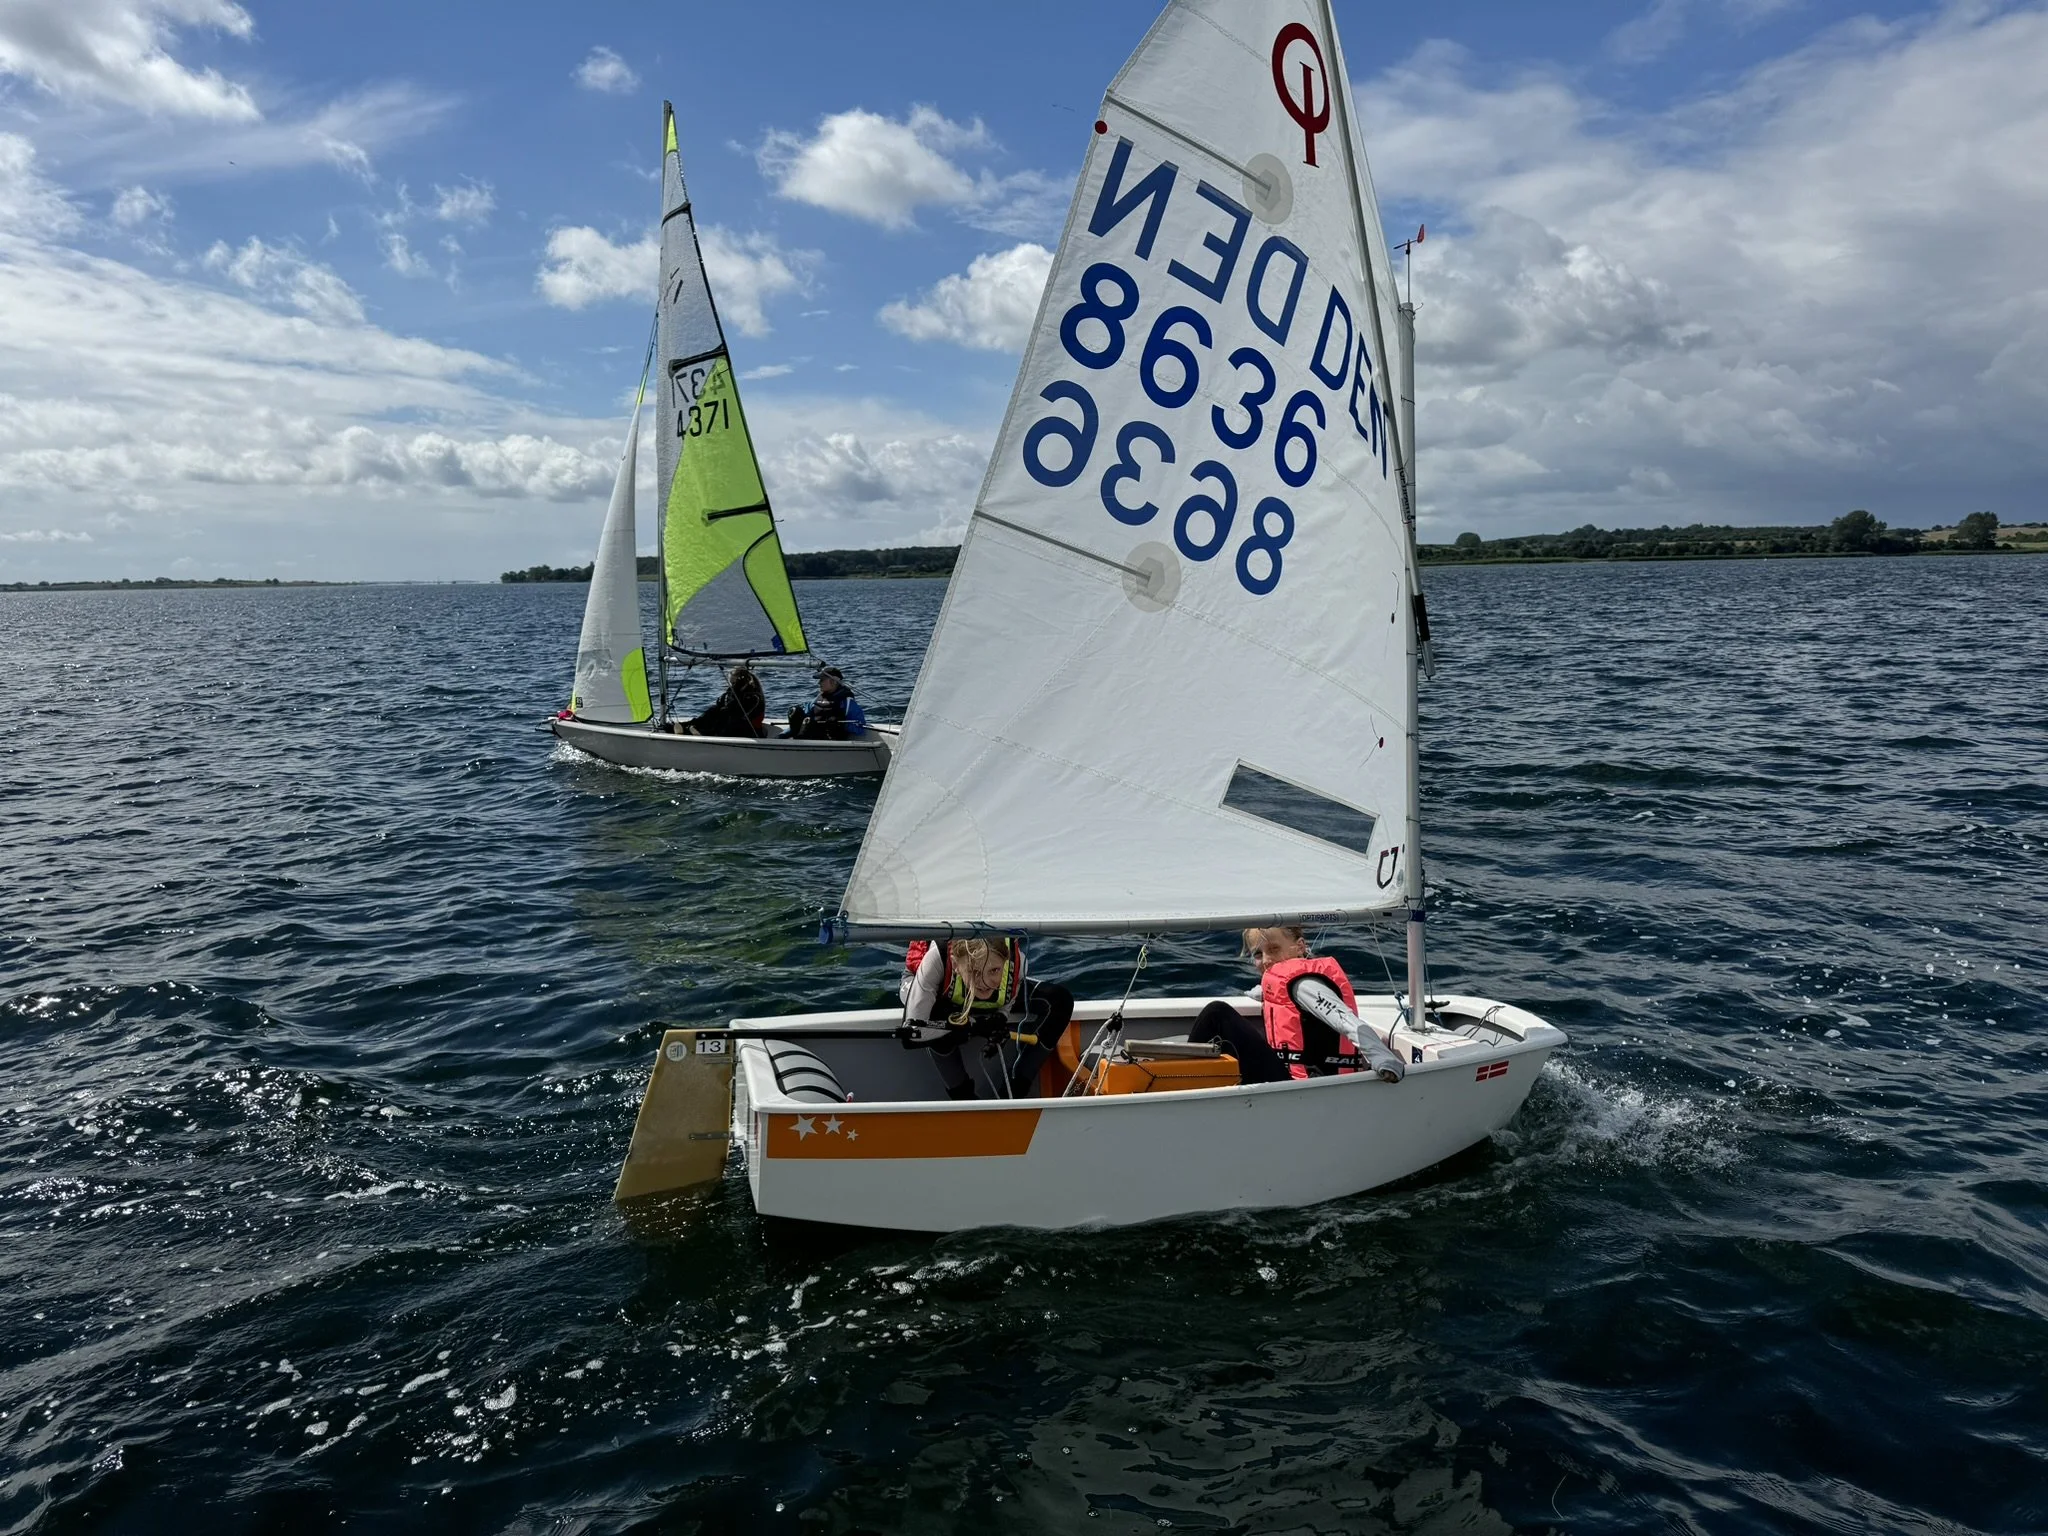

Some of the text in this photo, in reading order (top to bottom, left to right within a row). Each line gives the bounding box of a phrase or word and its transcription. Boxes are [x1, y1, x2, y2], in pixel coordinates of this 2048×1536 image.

[677, 398, 729, 440] 4371
[1059, 262, 1326, 488] 8636
[1309, 284, 1388, 480] DEN
[699, 1041, 721, 1053] 13
